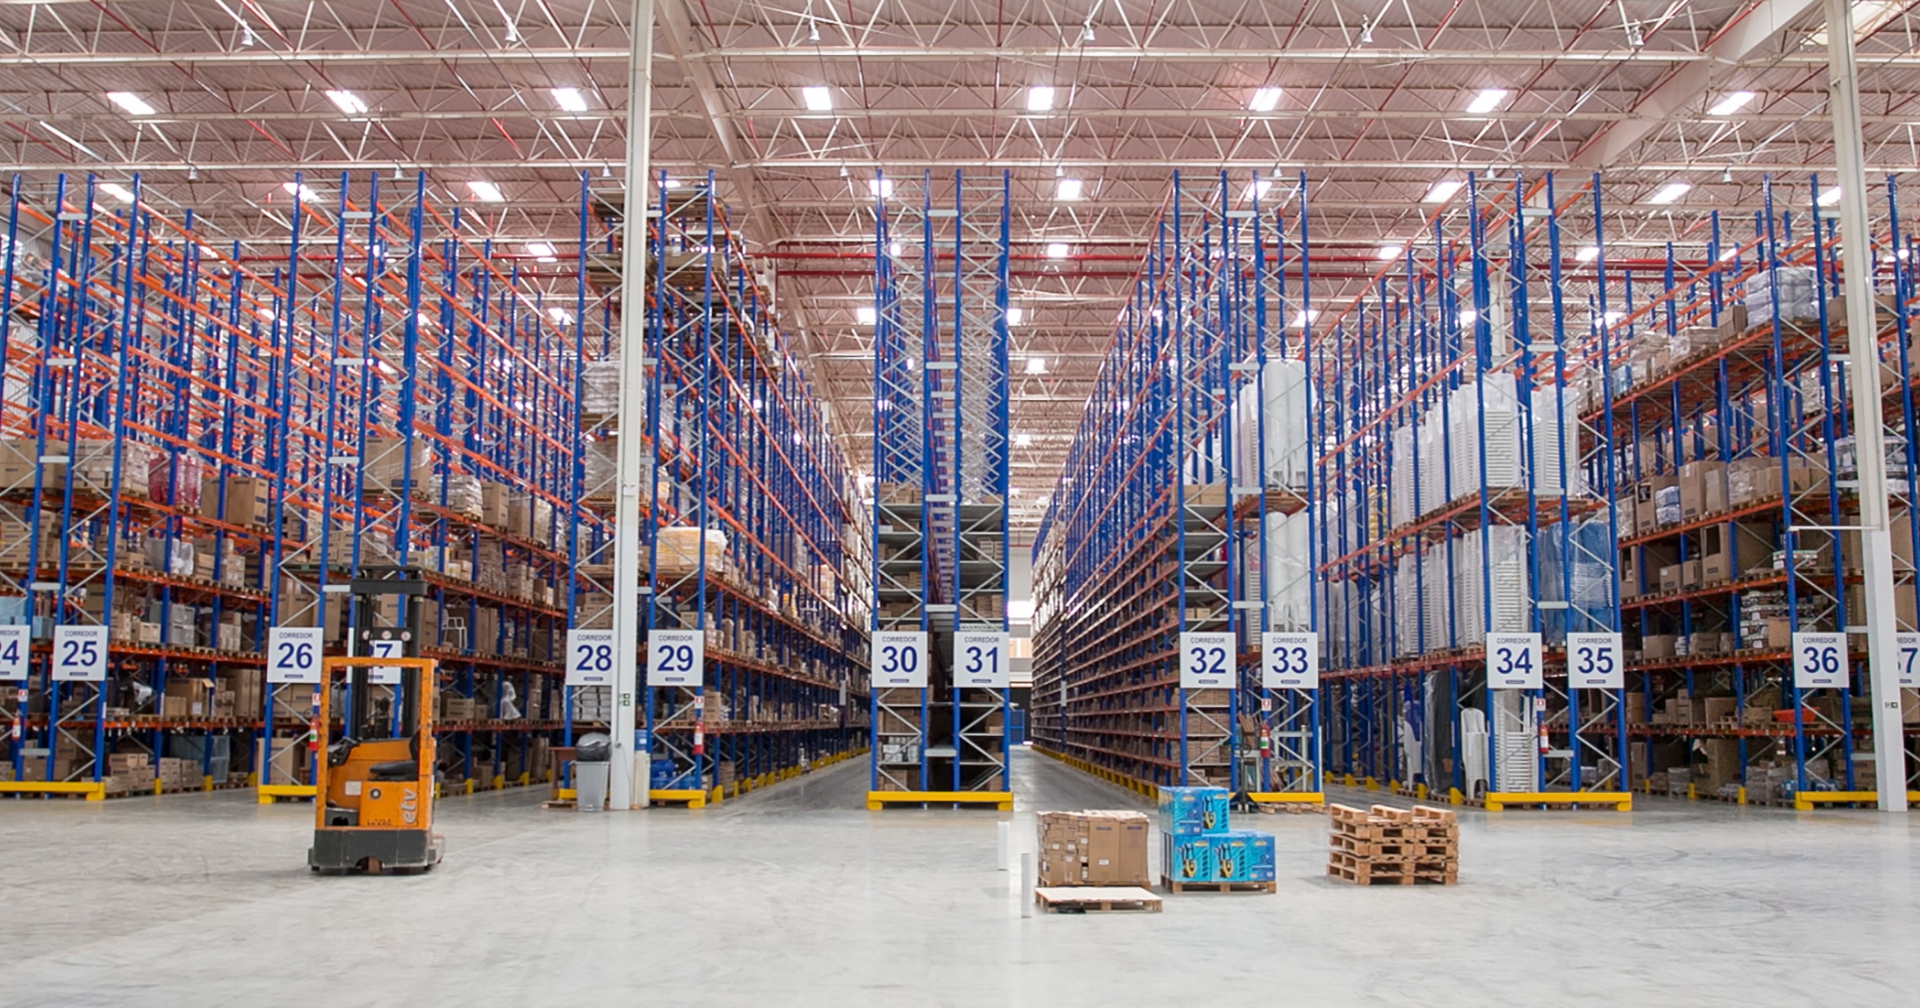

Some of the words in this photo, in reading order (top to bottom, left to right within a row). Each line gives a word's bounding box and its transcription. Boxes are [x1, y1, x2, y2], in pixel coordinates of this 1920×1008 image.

[0, 639, 20, 666] 4
[61, 640, 98, 667] 25
[276, 642, 313, 669] 26
[369, 643, 393, 669] 7
[576, 645, 612, 671] 28
[657, 645, 694, 671] 29
[881, 646, 918, 673] 30
[965, 646, 998, 673] 31
[1190, 647, 1226, 674] 32
[1272, 647, 1308, 674] 33
[1496, 647, 1533, 674] 34
[1577, 647, 1613, 674] 35
[1803, 647, 1839, 673] 36
[1897, 647, 1918, 674] 7
[400, 789, 418, 824] etv
